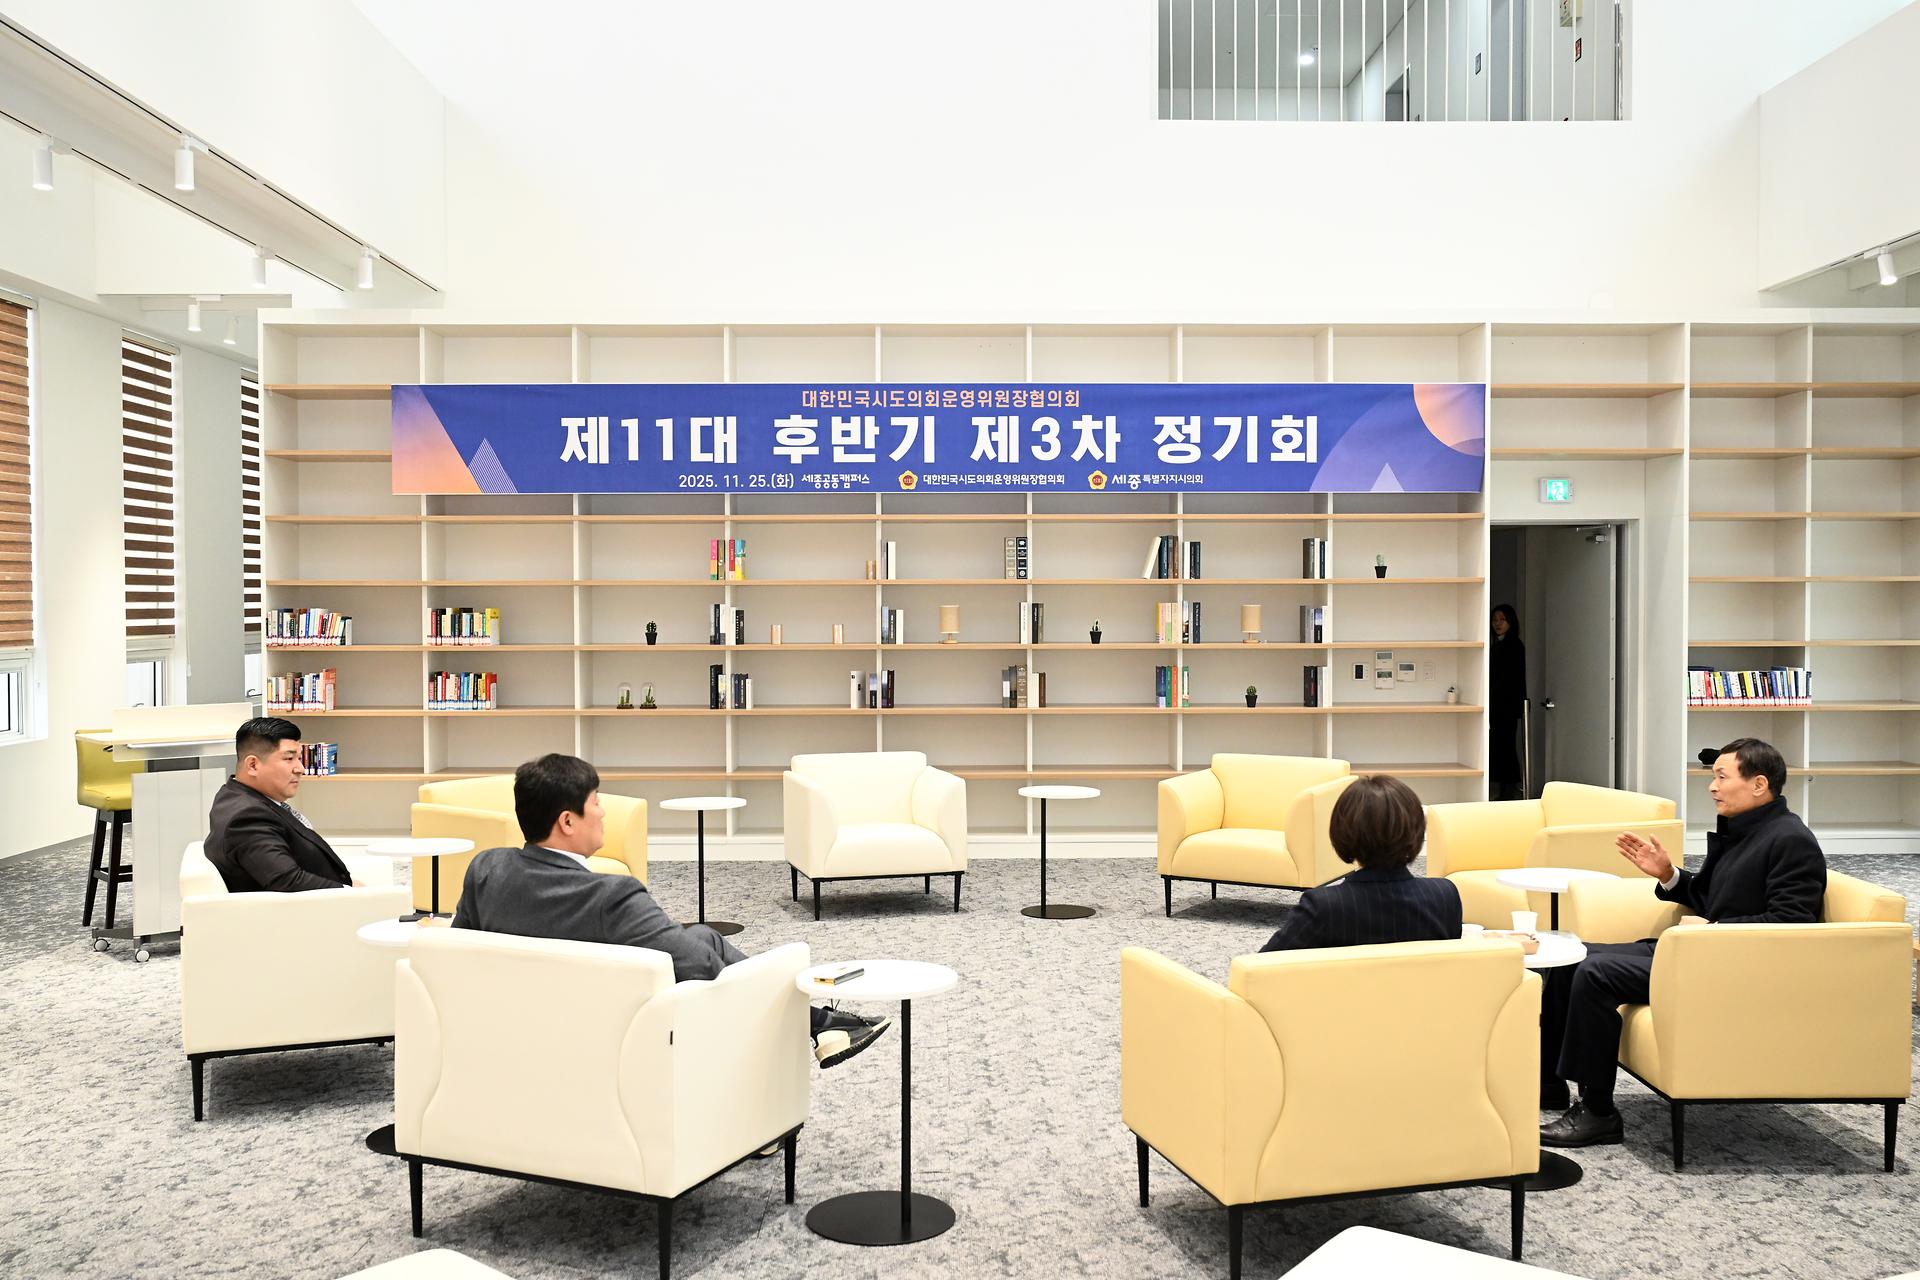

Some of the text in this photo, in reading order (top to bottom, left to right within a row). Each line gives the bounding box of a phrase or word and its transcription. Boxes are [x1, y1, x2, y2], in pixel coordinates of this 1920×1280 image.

[802, 389, 1080, 408] 대한민국시도의회운영위원장협의회
[559, 415, 1318, 464] 제11대 후반기 제3차 정기회
[678, 473, 870, 489] 2025. 11. 25.(화) 세종공동캠퍼스
[922, 473, 1065, 486] 대한민국시도의회운영위원장협의회
